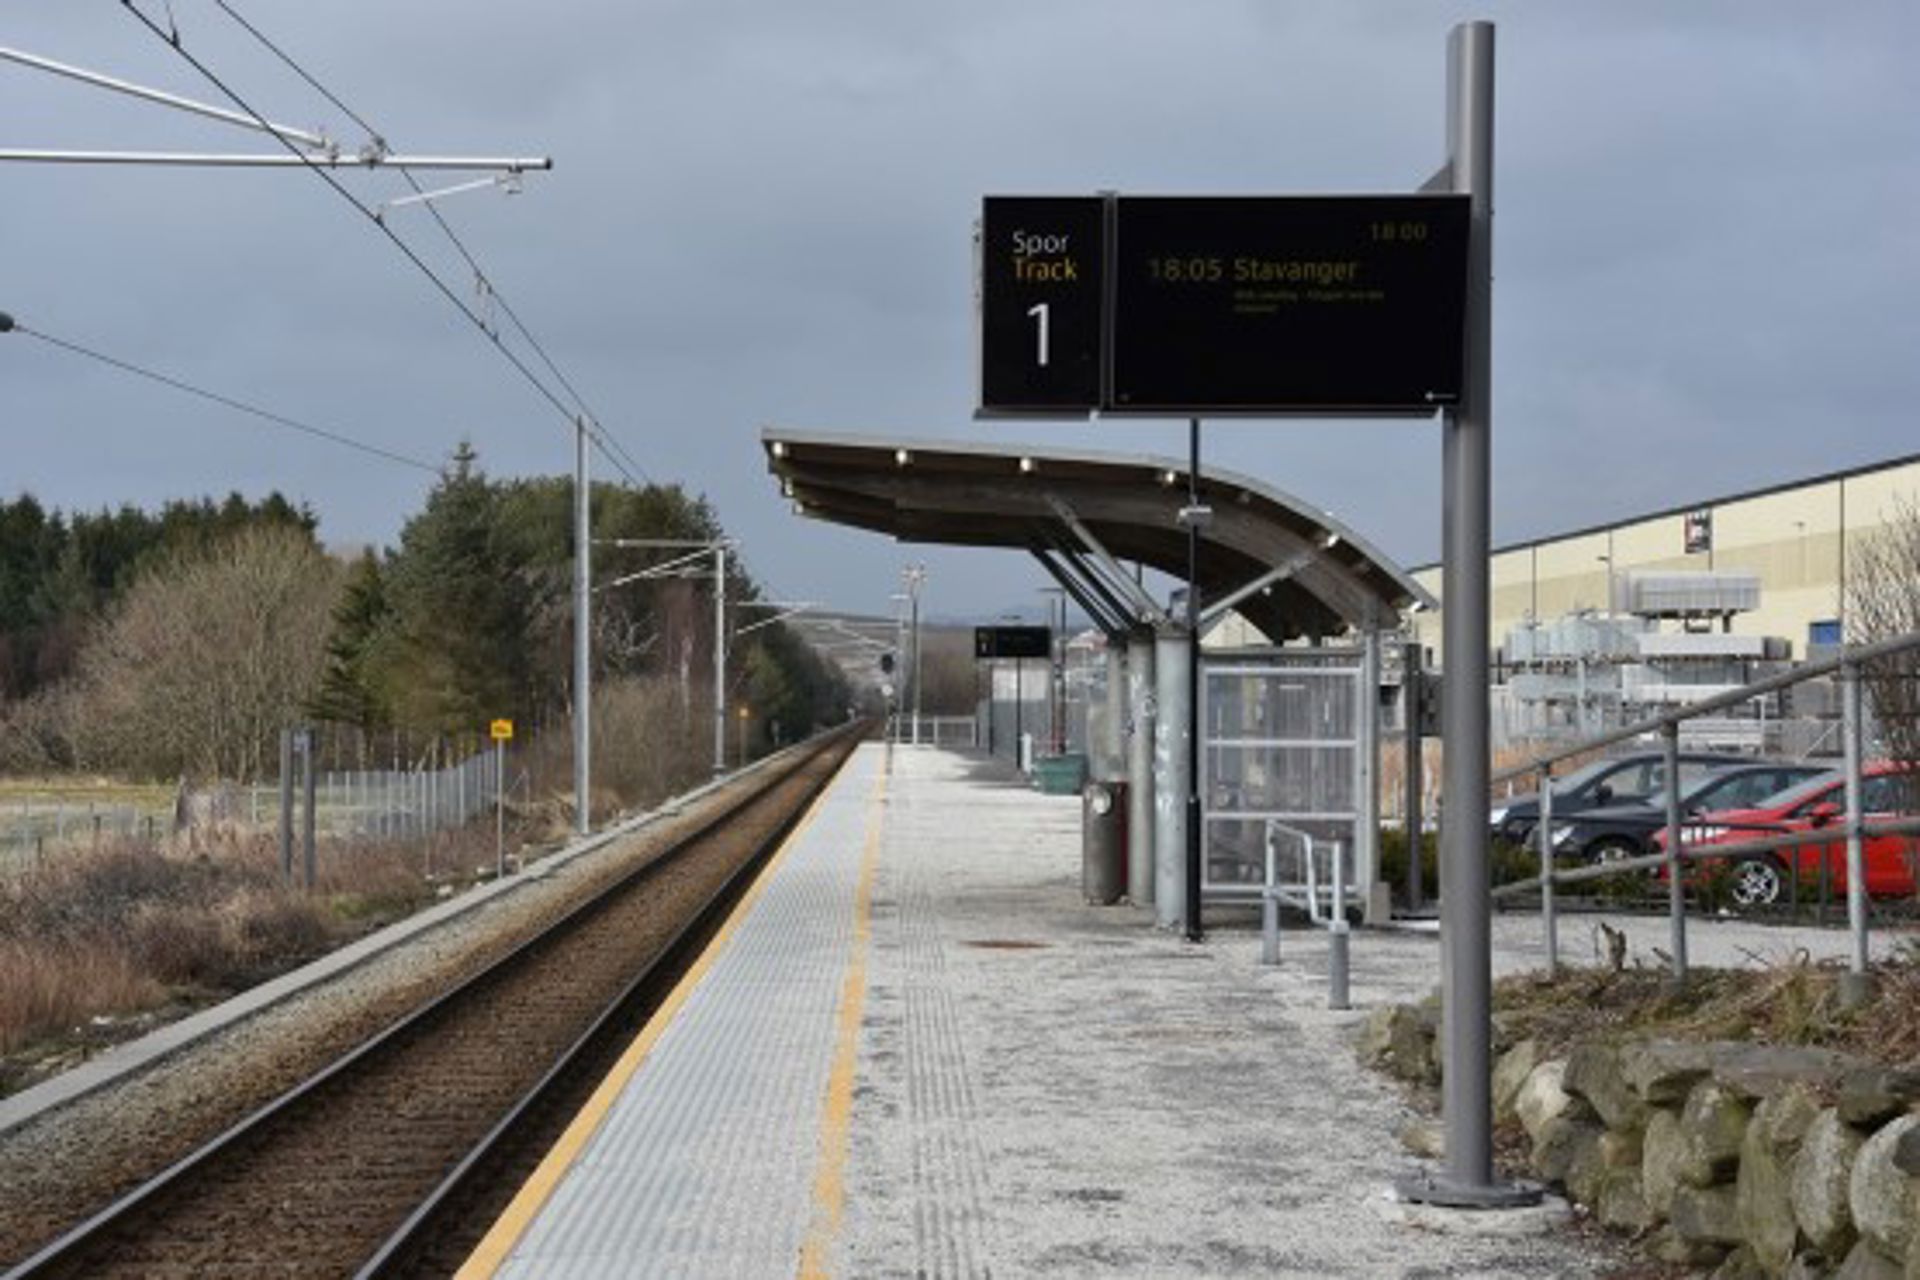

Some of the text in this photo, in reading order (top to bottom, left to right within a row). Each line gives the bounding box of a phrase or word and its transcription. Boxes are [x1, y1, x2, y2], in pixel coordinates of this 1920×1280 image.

[1013, 230, 1069, 257] Spor
[1370, 222, 1428, 241] 1800
[1013, 258, 1077, 282] Track
[1150, 257, 1359, 284] 18:05 Stavanger
[1027, 302, 1050, 367] 1
